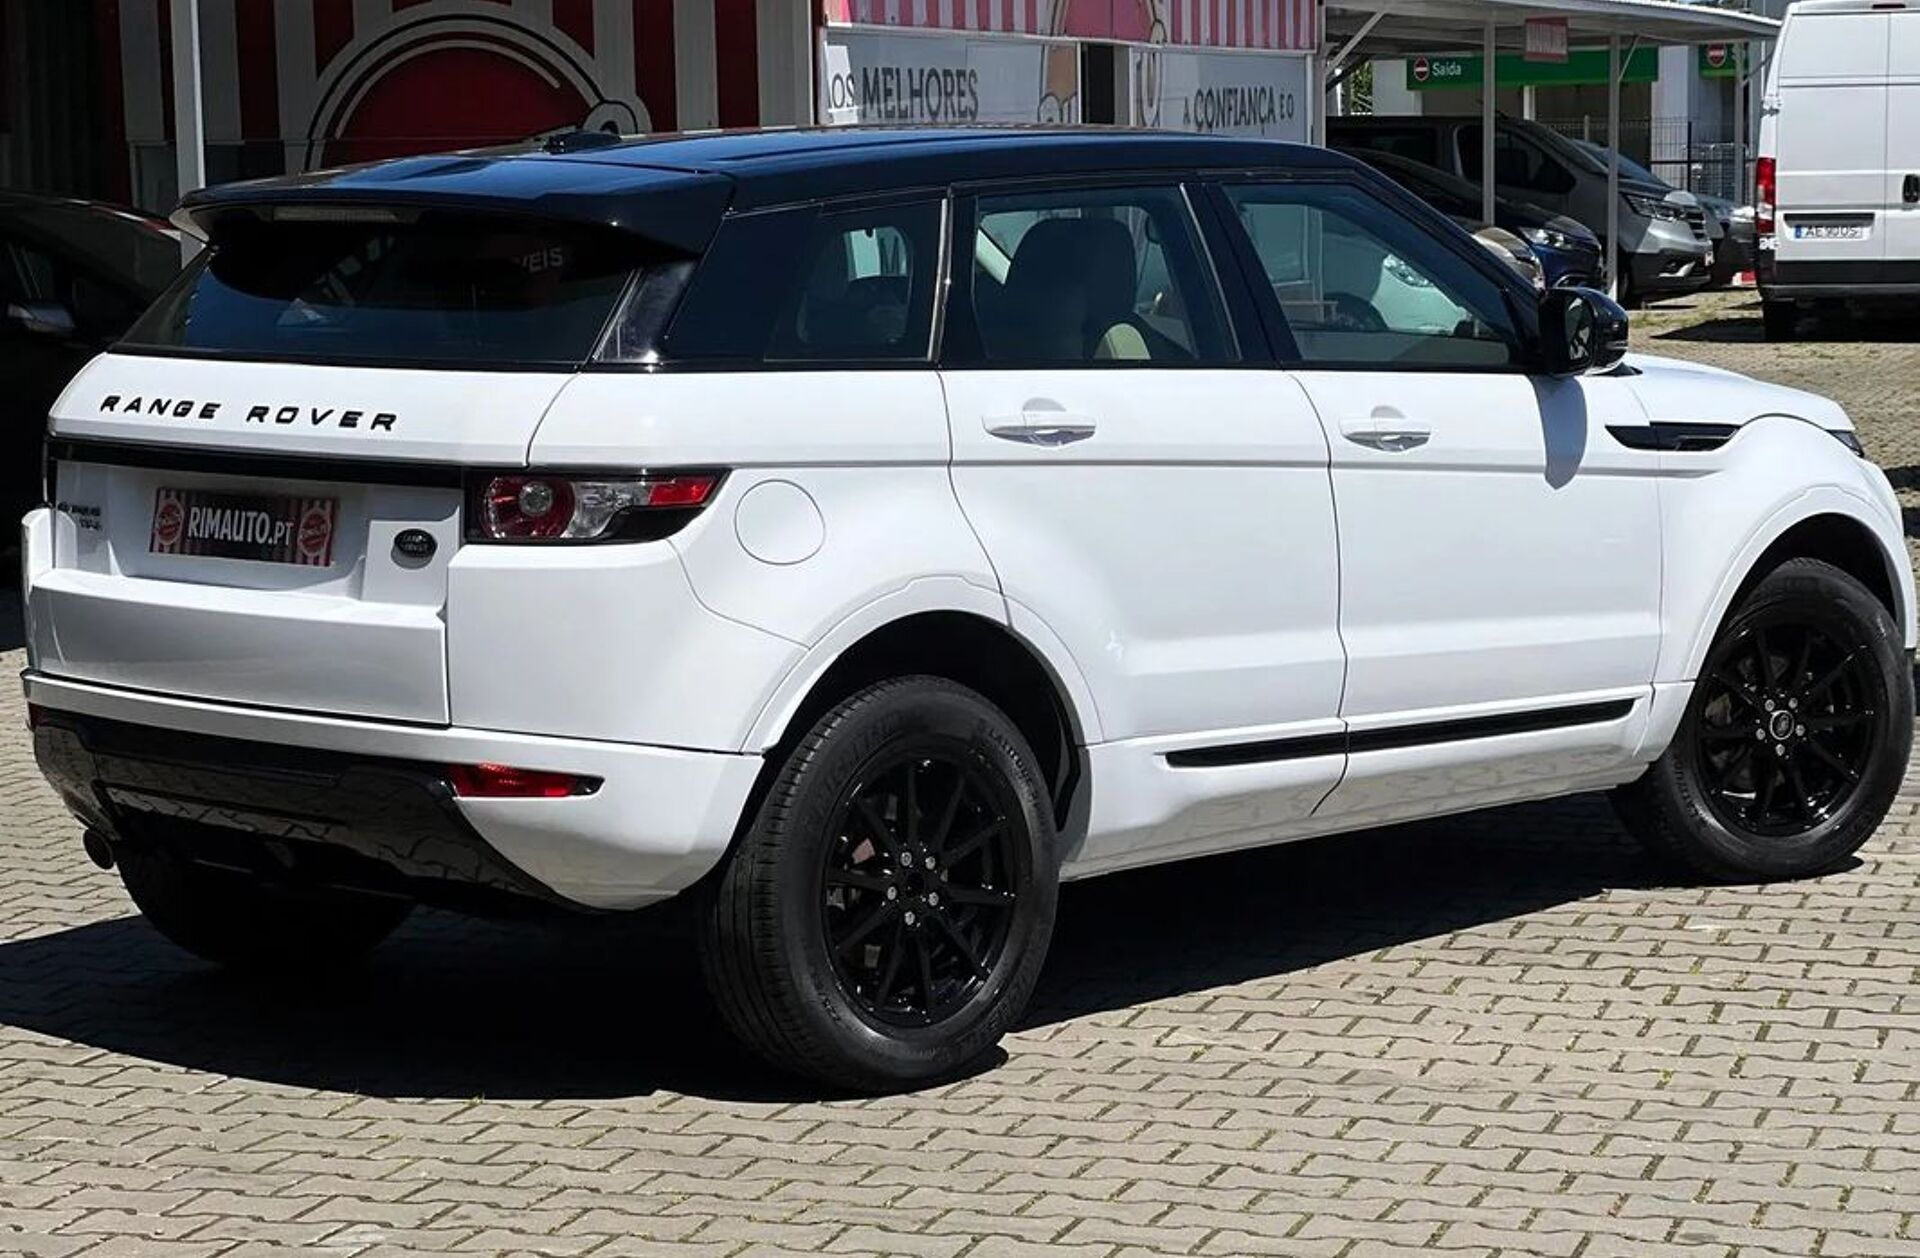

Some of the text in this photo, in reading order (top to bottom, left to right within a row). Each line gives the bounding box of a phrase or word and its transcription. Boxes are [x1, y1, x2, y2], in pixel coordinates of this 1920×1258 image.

[862, 67, 979, 121] MELHORES
[1183, 96, 1191, 125] A
[1193, 86, 1276, 136] CONFIANÇA
[1286, 93, 1294, 120] O
[99, 395, 397, 432] RANGE ROVER
[188, 506, 295, 546] RIMAUTO.PT
